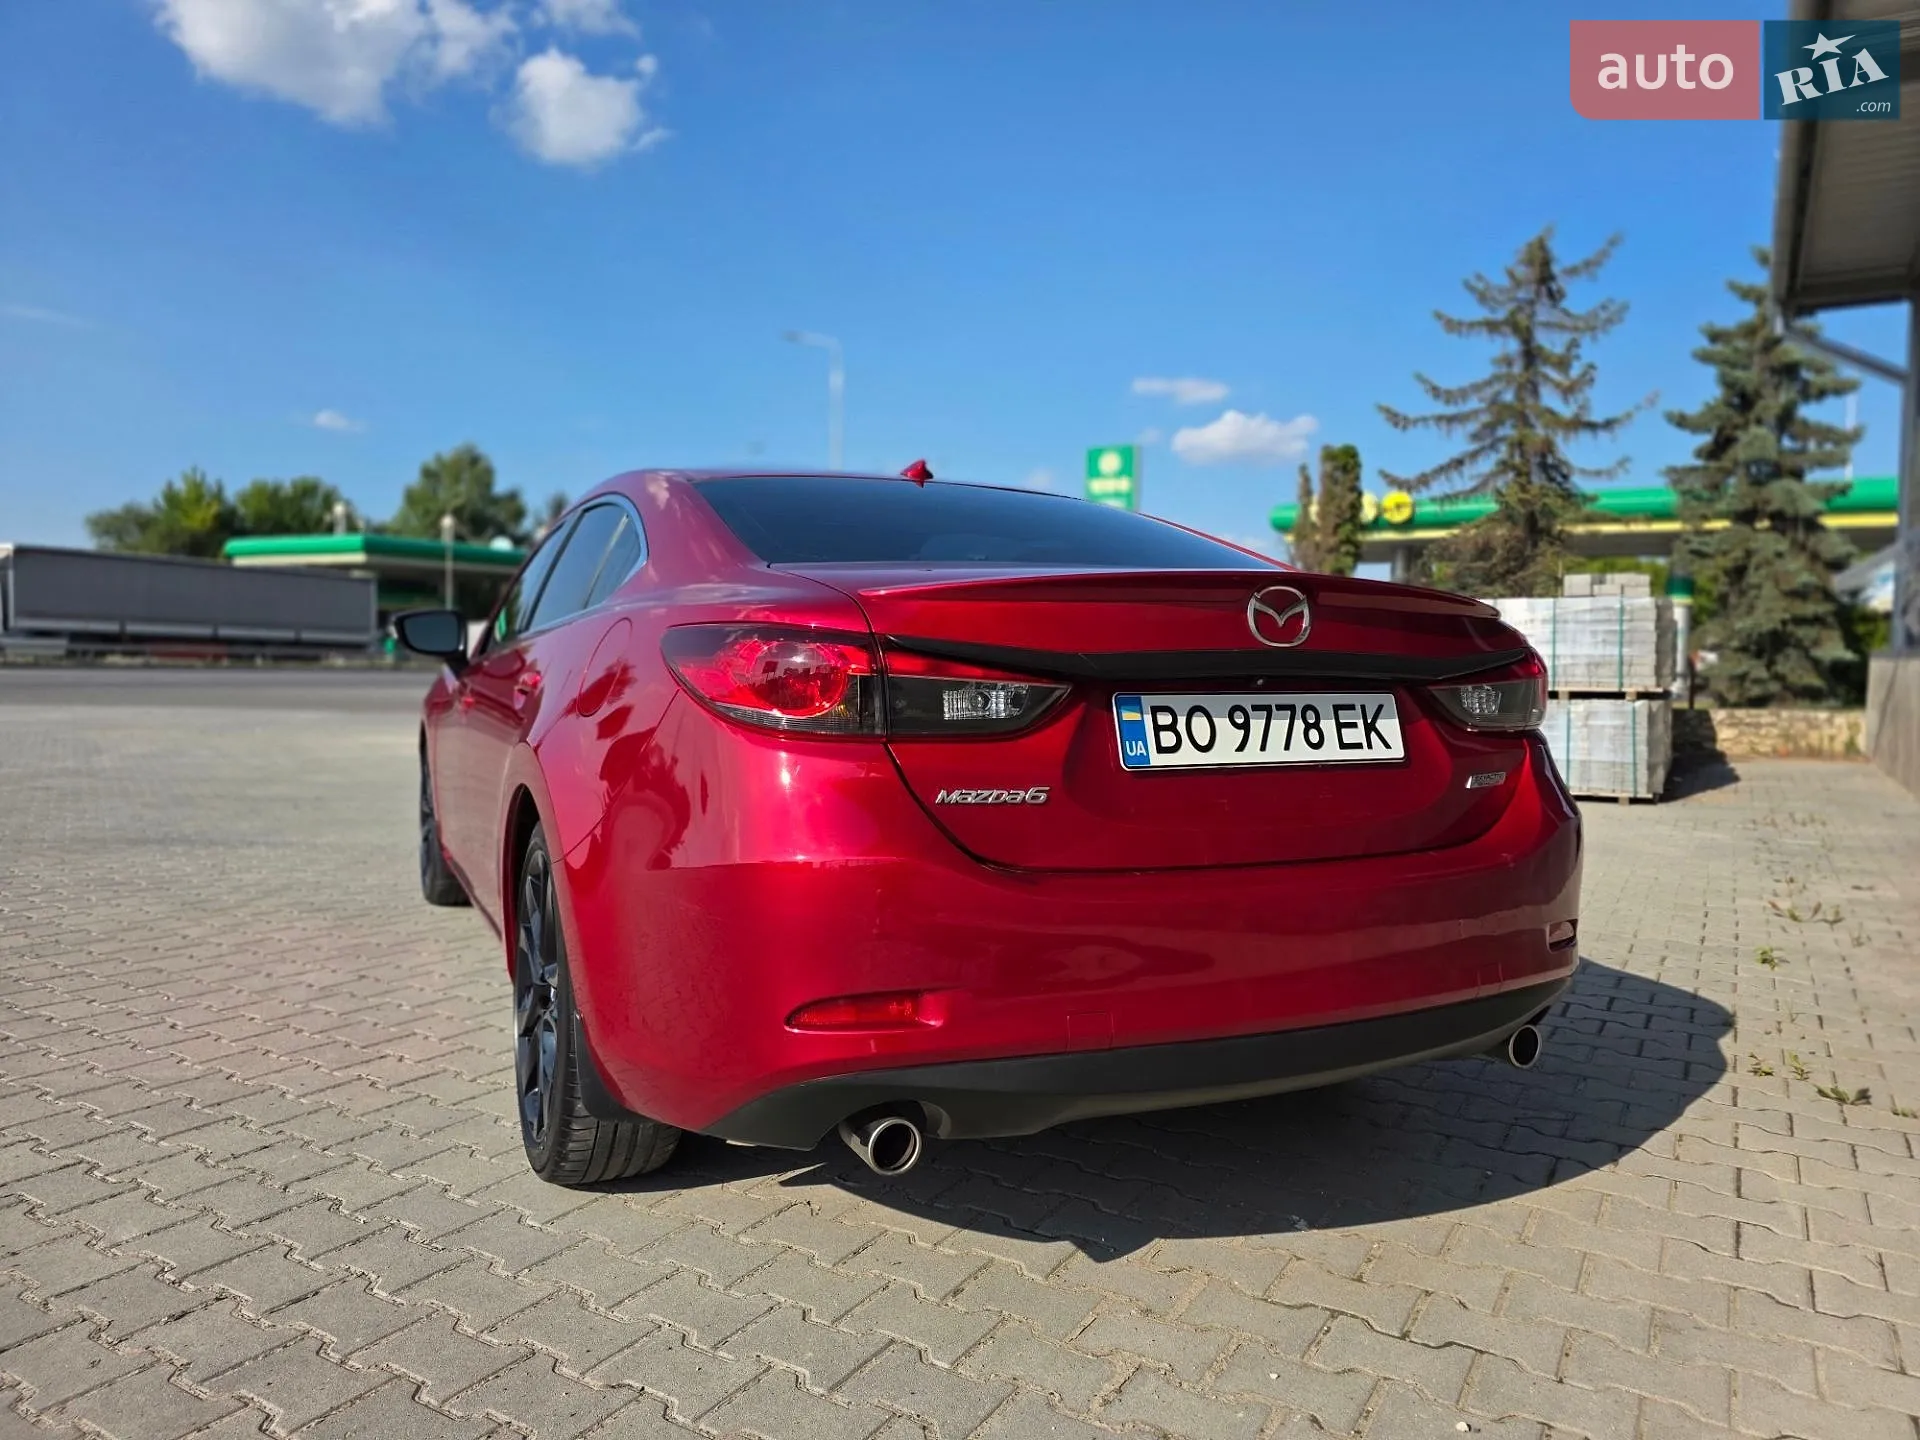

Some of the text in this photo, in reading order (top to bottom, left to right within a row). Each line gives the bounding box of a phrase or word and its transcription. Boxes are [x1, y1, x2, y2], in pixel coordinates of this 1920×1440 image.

[1149, 703, 1392, 755] BO 9778 EK
[1125, 740, 1146, 756] UA
